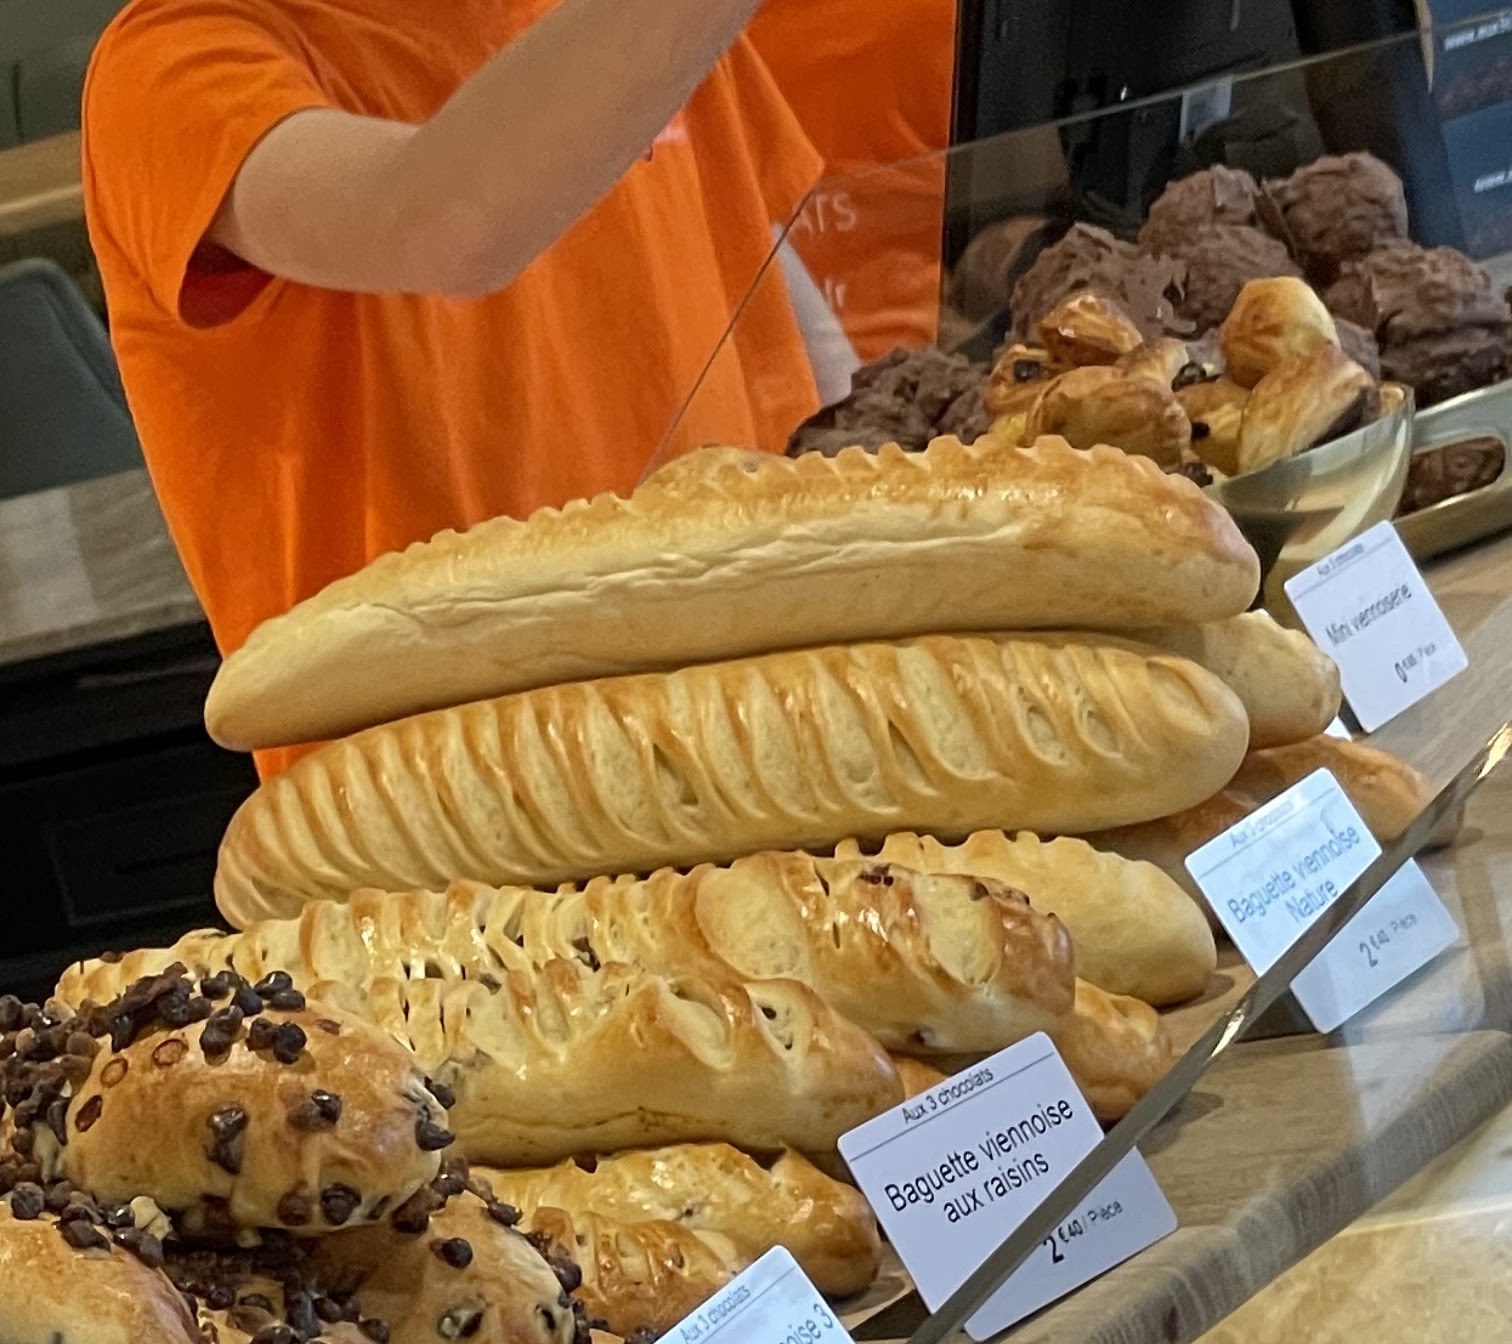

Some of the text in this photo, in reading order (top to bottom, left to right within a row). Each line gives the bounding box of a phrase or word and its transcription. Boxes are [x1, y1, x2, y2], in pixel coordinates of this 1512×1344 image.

[1226, 870, 1296, 924] Baguette
[1285, 878, 1339, 926] Nature
[902, 1104, 928, 1125] Aux
[926, 1095, 938, 1110] 3
[885, 1099, 1074, 1213] Baguette viennoise
[942, 1152, 1050, 1224] aux raisins
[813, 1303, 835, 1330] 3
